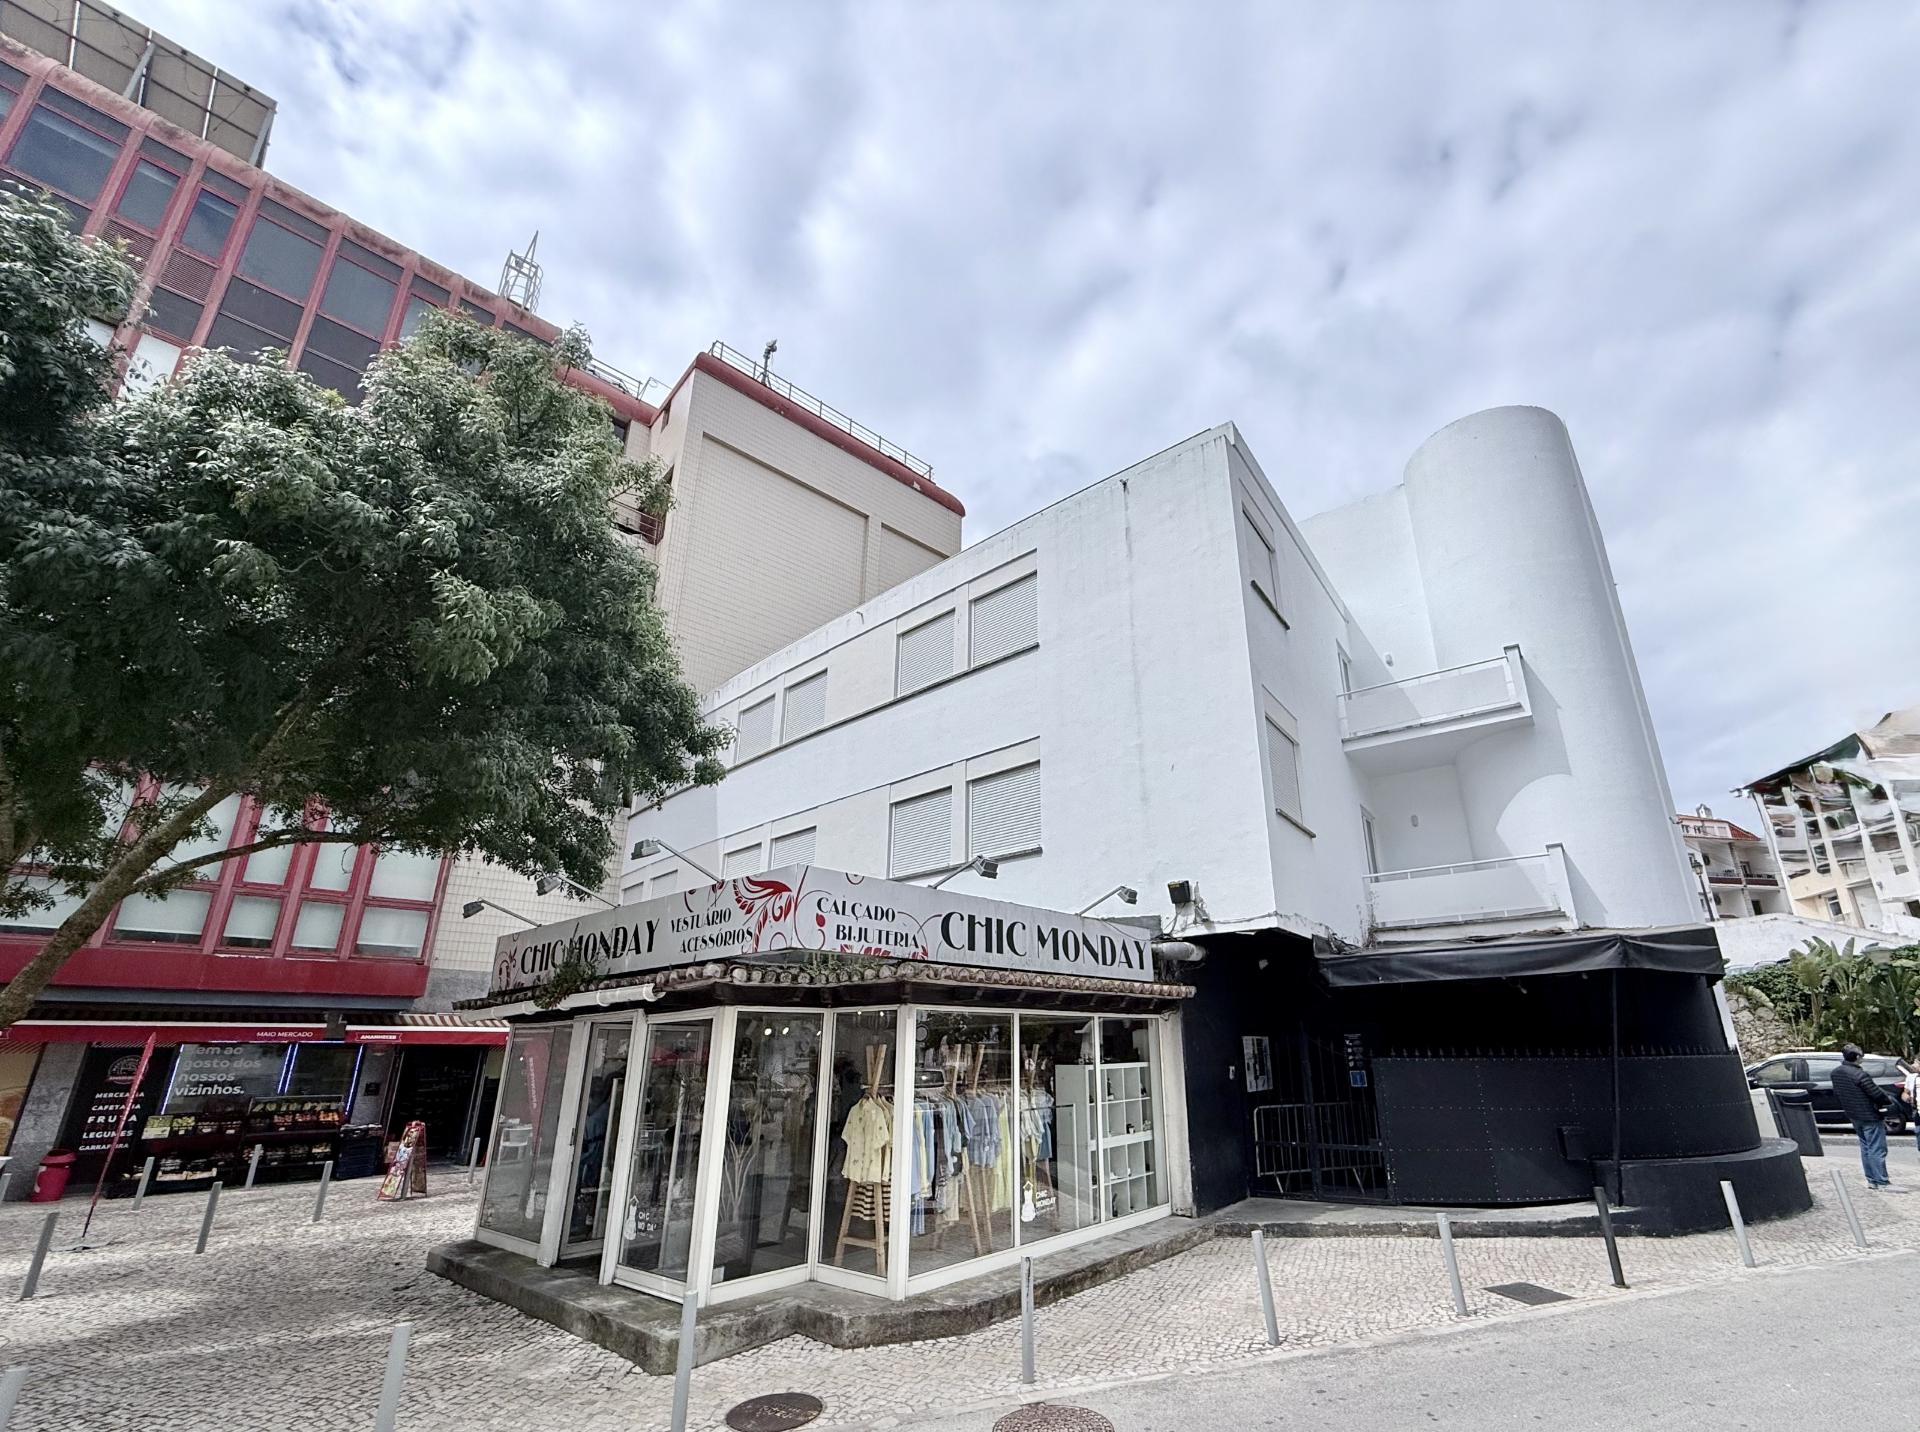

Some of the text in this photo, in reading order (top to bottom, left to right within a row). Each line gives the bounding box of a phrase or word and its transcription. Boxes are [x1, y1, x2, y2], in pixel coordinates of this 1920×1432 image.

[670, 907, 732, 933] VESTUÁRIO
[816, 896, 896, 922] CALÇADO
[679, 926, 753, 954] ACESSÓRIOS
[835, 924, 919, 949] BIJUTERIA
[940, 911, 1147, 970] CHIC MONDAY
[520, 939, 564, 974] CHIC
[178, 1072, 236, 1082] nossos
[182, 1058, 261, 1071] gosto dos
[95, 1091, 145, 1099] MERCEAIA
[174, 1083, 245, 1096] vizinhos.
[91, 1103, 141, 1111] CAFETAIA
